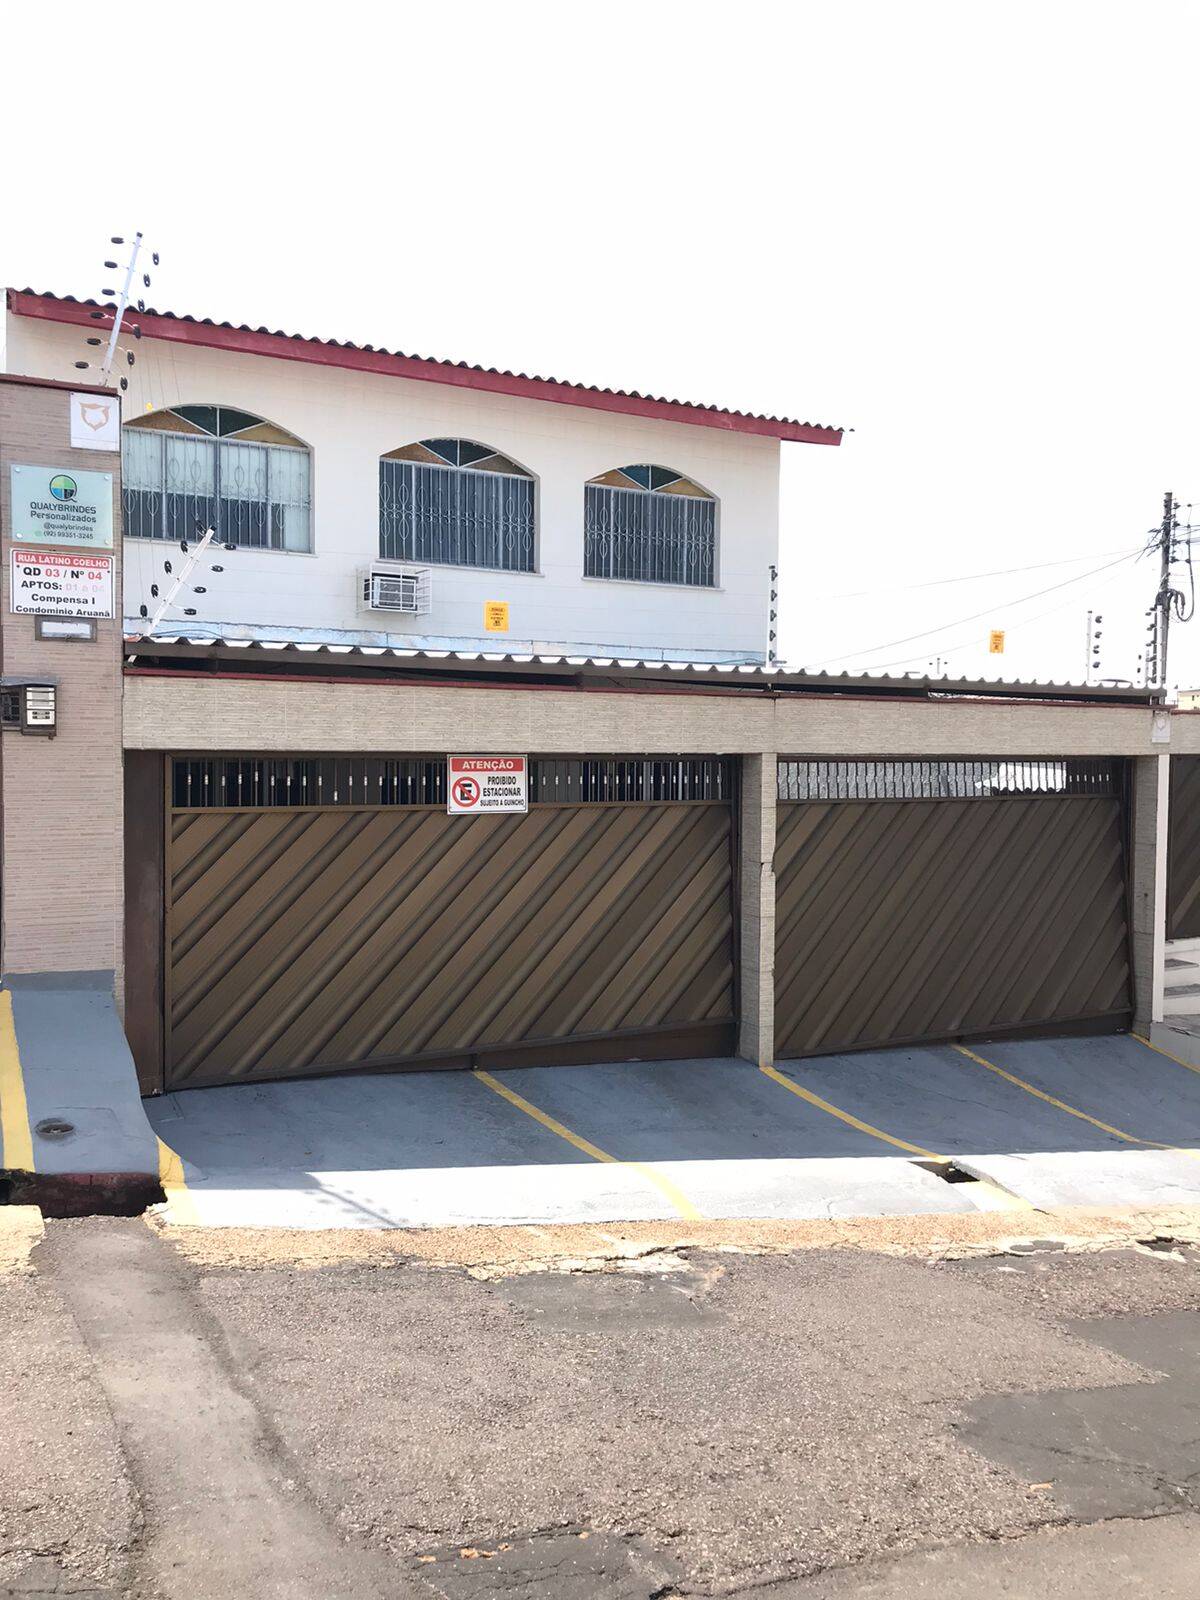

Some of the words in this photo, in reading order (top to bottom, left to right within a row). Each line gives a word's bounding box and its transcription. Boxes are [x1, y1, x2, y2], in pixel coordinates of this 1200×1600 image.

[30, 501, 97, 515] QUALYBRINDES
[30, 510, 97, 523] Personalizados
[43, 521, 94, 532] @qualybrindes
[17, 554, 37, 563] RUA
[39, 556, 71, 566] LATINO
[72, 558, 109, 568] COELHO
[23, 566, 41, 576] QD
[45, 568, 60, 577] 03
[63, 569, 68, 578] /
[87, 571, 103, 580] 04
[21, 580, 63, 590] APTOS:
[31, 593, 89, 605] Compensa
[462, 759, 514, 771] ATENÇÃO
[487, 776, 517, 785] PROIBIDO
[482, 787, 521, 797] ESTACIONAR
[480, 799, 499, 807] SUJEITO
[504, 799, 525, 807] GUINCHO
